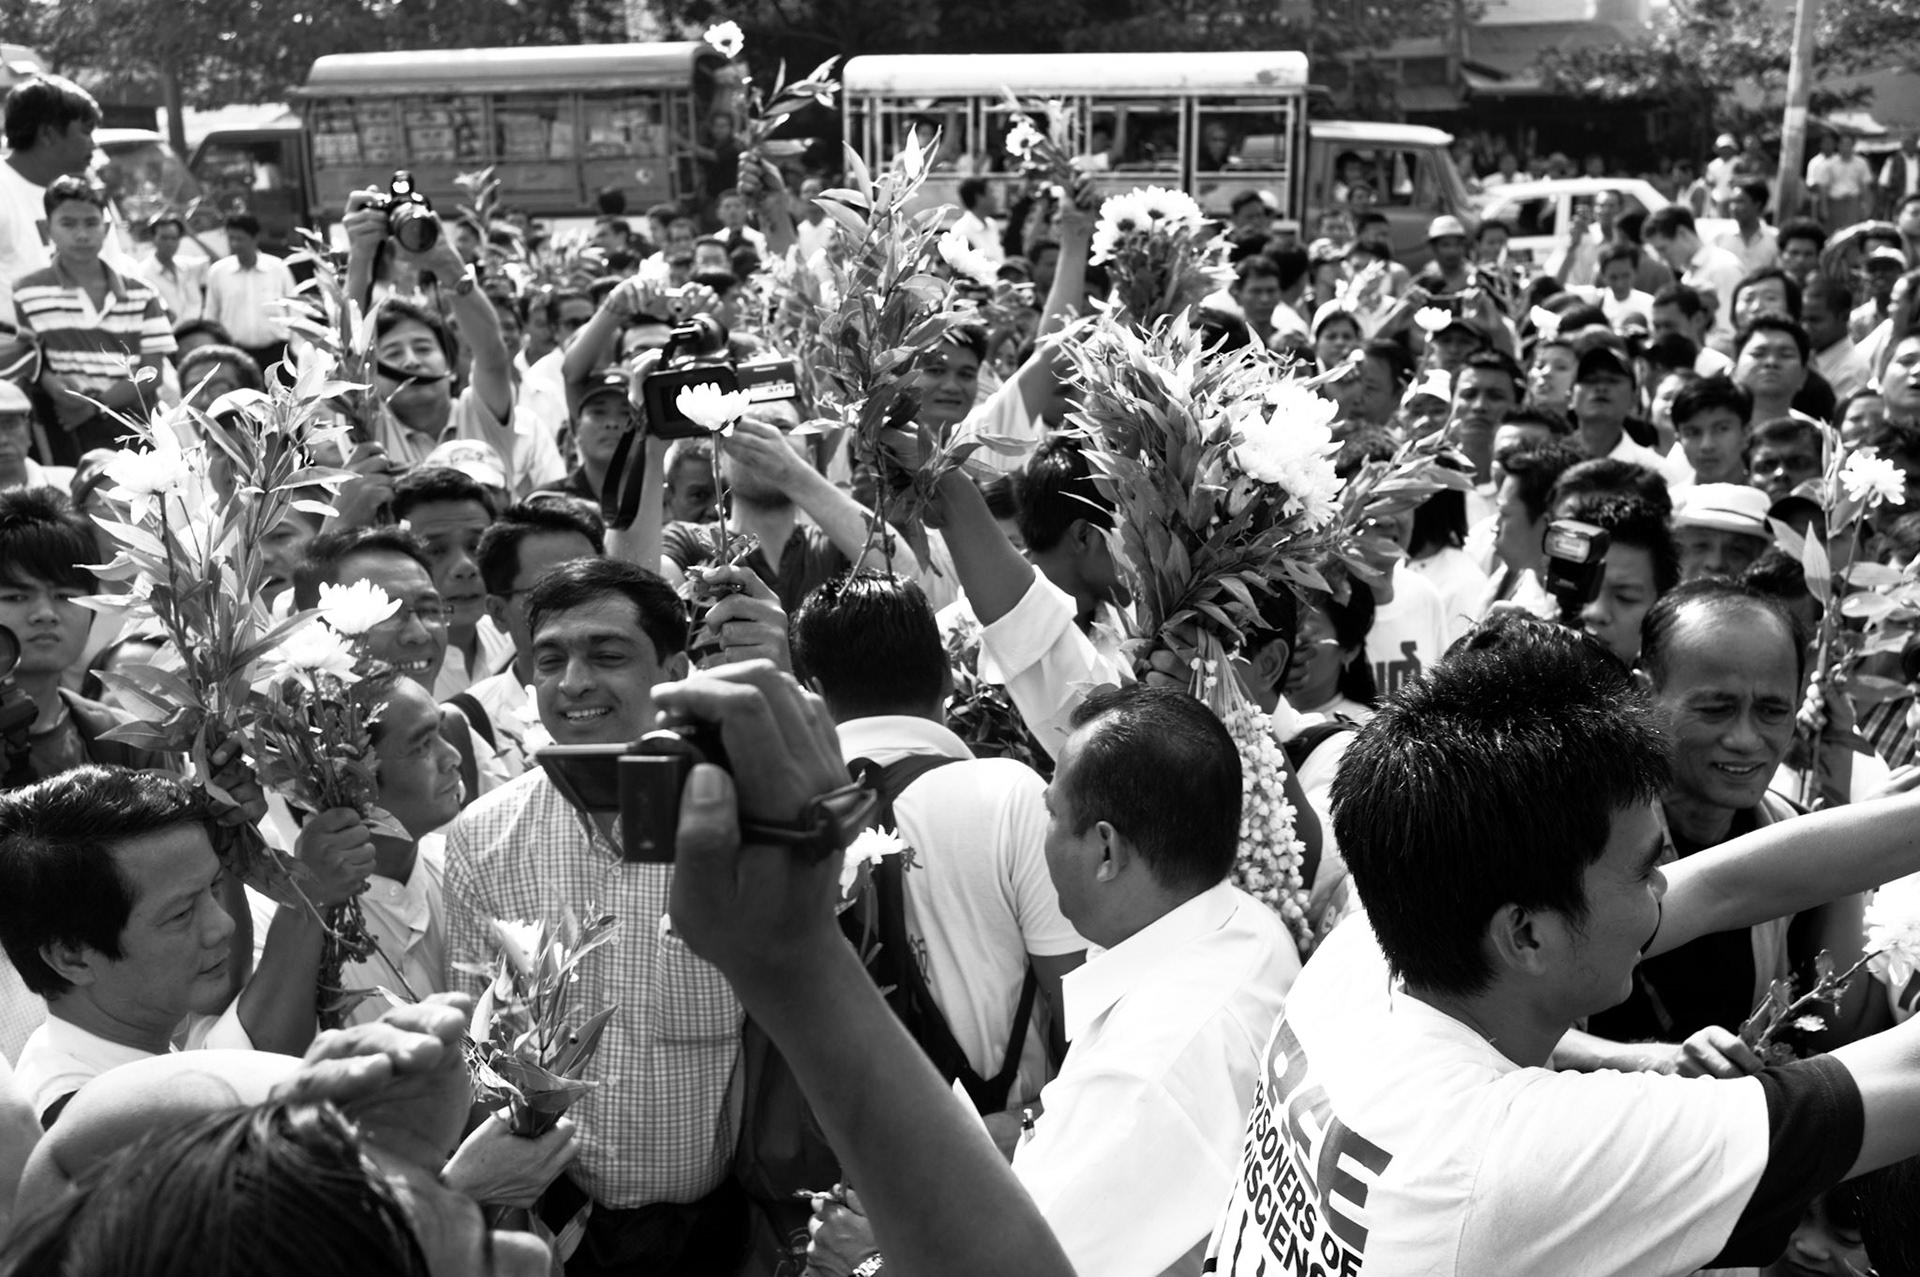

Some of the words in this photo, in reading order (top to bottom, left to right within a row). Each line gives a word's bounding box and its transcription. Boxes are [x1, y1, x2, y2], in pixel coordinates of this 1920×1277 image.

[1244, 1122, 1328, 1277] NSCIEN
[1254, 1076, 1318, 1242] RISONERS
[1320, 1231, 1363, 1277] OF
[1267, 1018, 1394, 1254] REE
